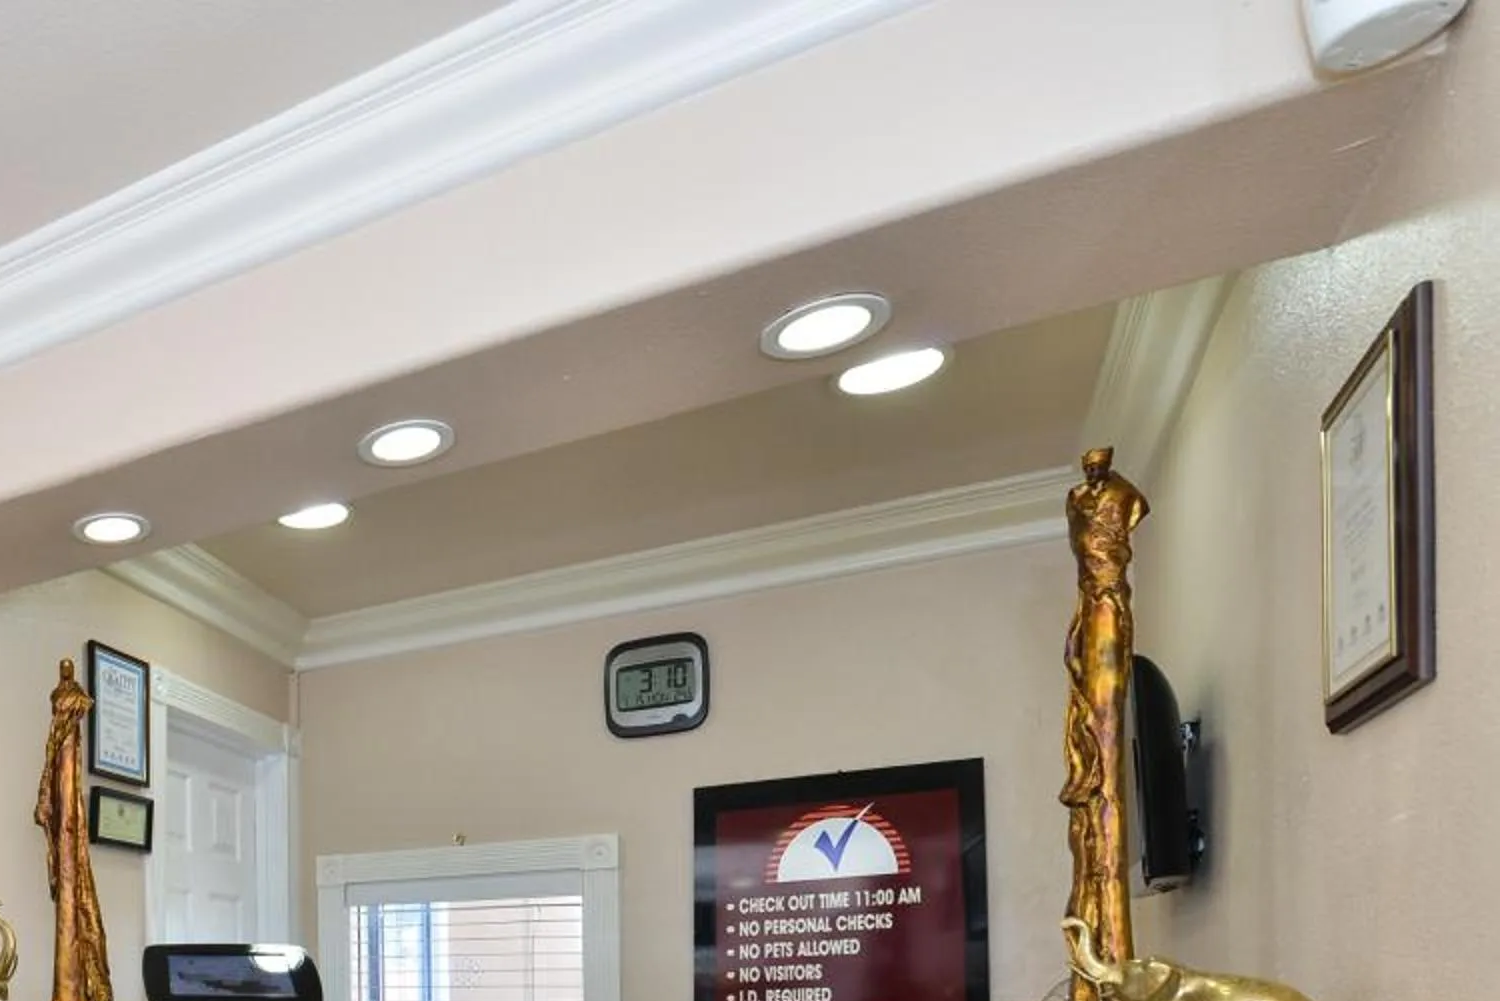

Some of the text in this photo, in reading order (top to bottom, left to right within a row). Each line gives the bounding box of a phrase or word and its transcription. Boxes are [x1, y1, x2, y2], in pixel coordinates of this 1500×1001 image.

[739, 886, 921, 914] CHECK OUT TIME 11:00 AM
[739, 913, 893, 937] NO PERSONAL CHECKS
[739, 938, 861, 960] NO PETS ALLOWED
[739, 963, 823, 983] NO VISITORS
